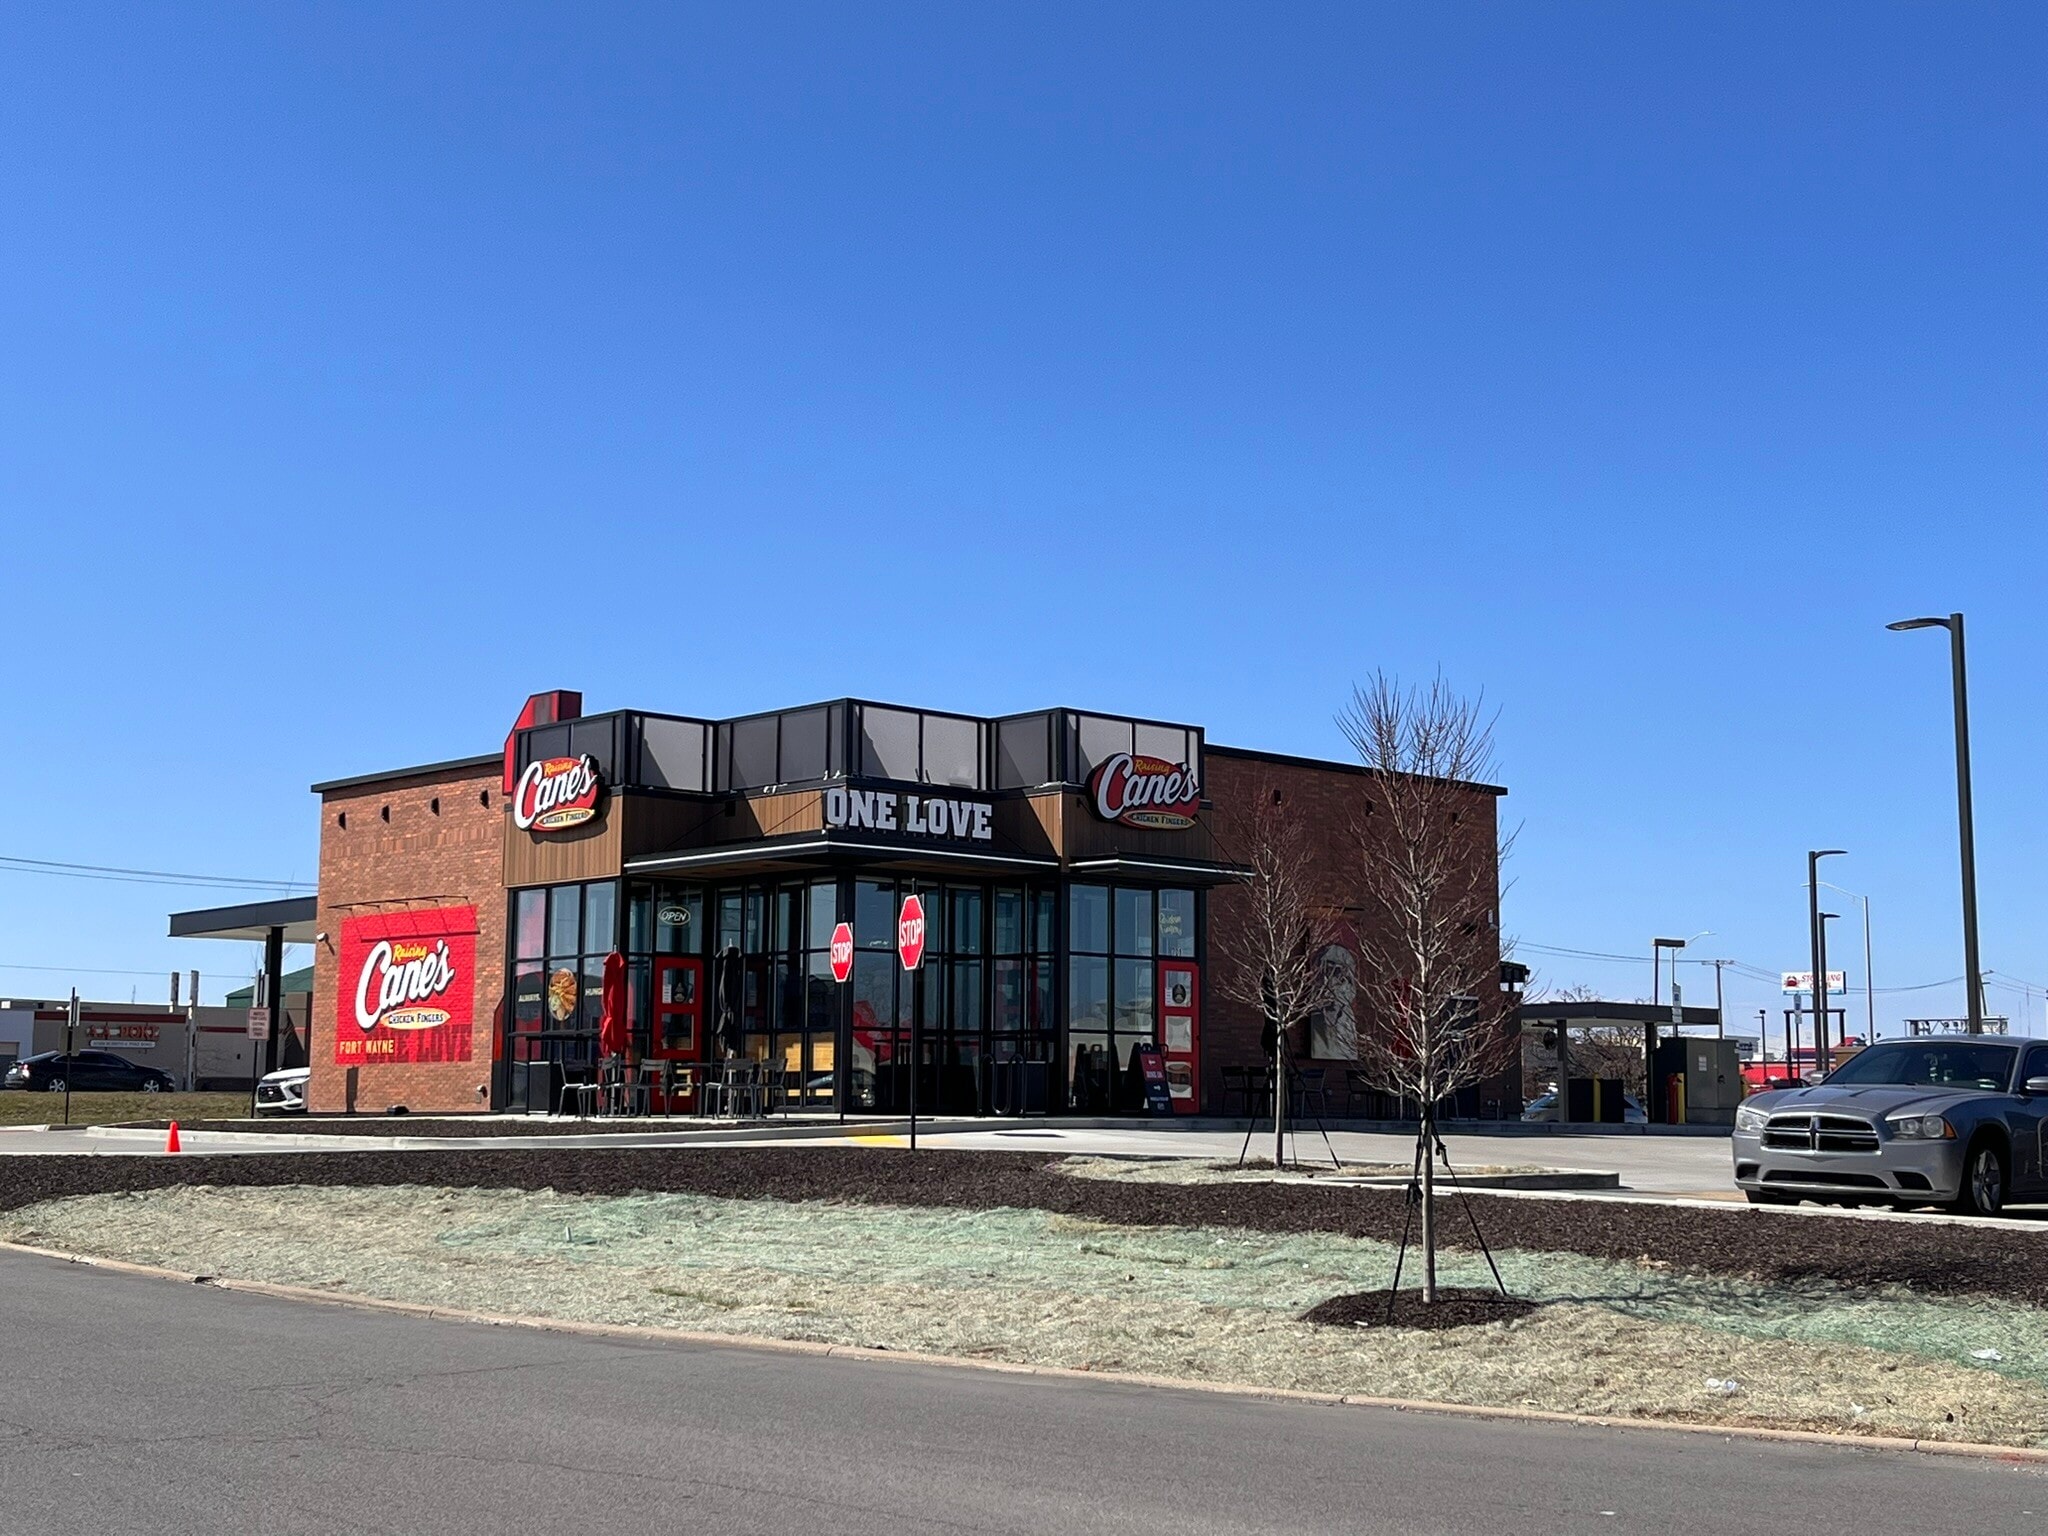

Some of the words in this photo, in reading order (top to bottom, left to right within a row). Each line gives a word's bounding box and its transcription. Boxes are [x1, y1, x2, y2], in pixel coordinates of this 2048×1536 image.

[544, 761, 573, 777] Raising
[1133, 759, 1171, 775] Raising
[514, 753, 598, 829] Cane's
[1097, 752, 1200, 819] Cane's
[826, 788, 898, 831] ONE
[906, 795, 993, 840] LOVE
[661, 910, 688, 922] OPEN
[900, 918, 922, 948] STOP
[392, 943, 428, 961] Raising
[832, 942, 851, 964] STOP
[355, 939, 456, 1032] Cane's
[339, 1041, 363, 1055] FORT
[365, 1039, 395, 1054] WAYNE
